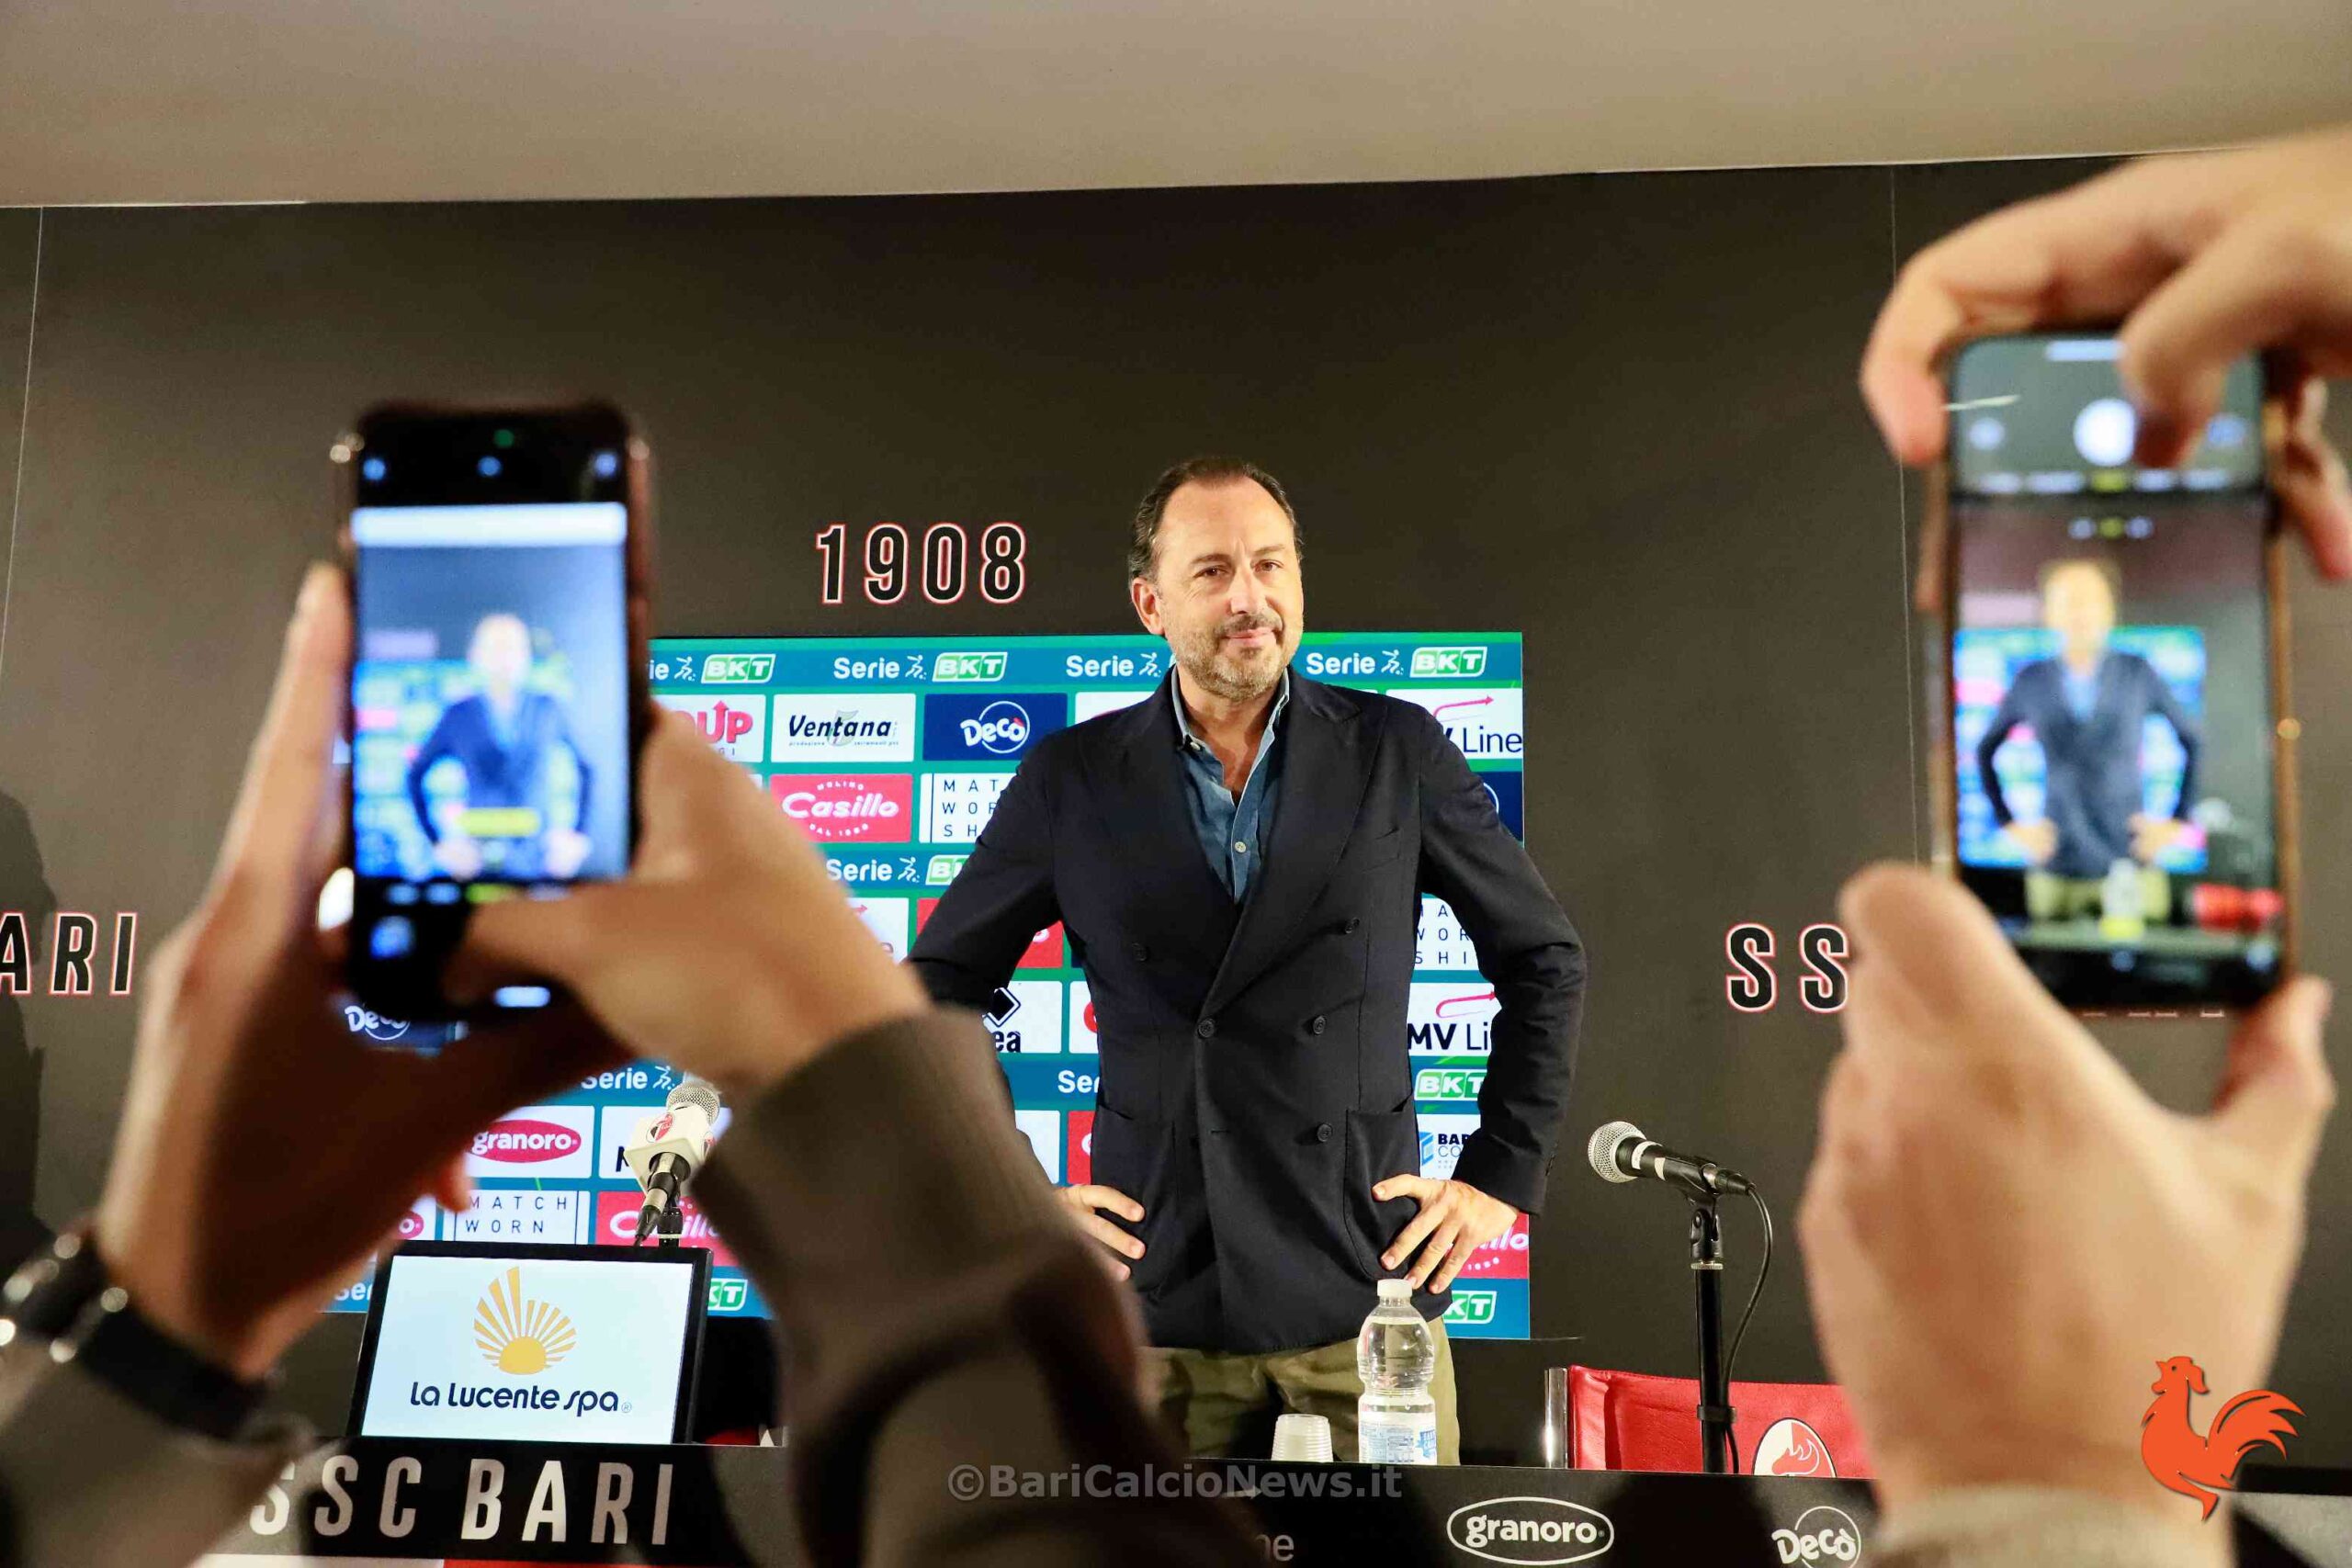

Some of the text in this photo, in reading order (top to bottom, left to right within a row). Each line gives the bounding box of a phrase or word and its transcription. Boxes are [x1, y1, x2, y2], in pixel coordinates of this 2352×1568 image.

[816, 523, 1025, 604] 1908
[707, 660, 770, 677] BKT
[833, 657, 1001, 679] Serie BKT
[1066, 655, 1134, 678] Serie
[1306, 653, 1481, 675] Serie BKT
[684, 701, 753, 744] UP
[789, 714, 892, 738] Ventana
[1463, 725, 1522, 752] Line
[817, 781, 864, 791] MOLINO
[782, 792, 899, 818] Casillo
[826, 858, 892, 881] Serie
[1420, 1076, 1486, 1094] BKT
[471, 1131, 572, 1155] granoro
[469, 1196, 567, 1210] MATCH
[466, 1220, 544, 1233] WORN
[563, 1390, 618, 1417] spa
[250, 1455, 673, 1545] SSC BARI
[1465, 1514, 1598, 1548] granoro
